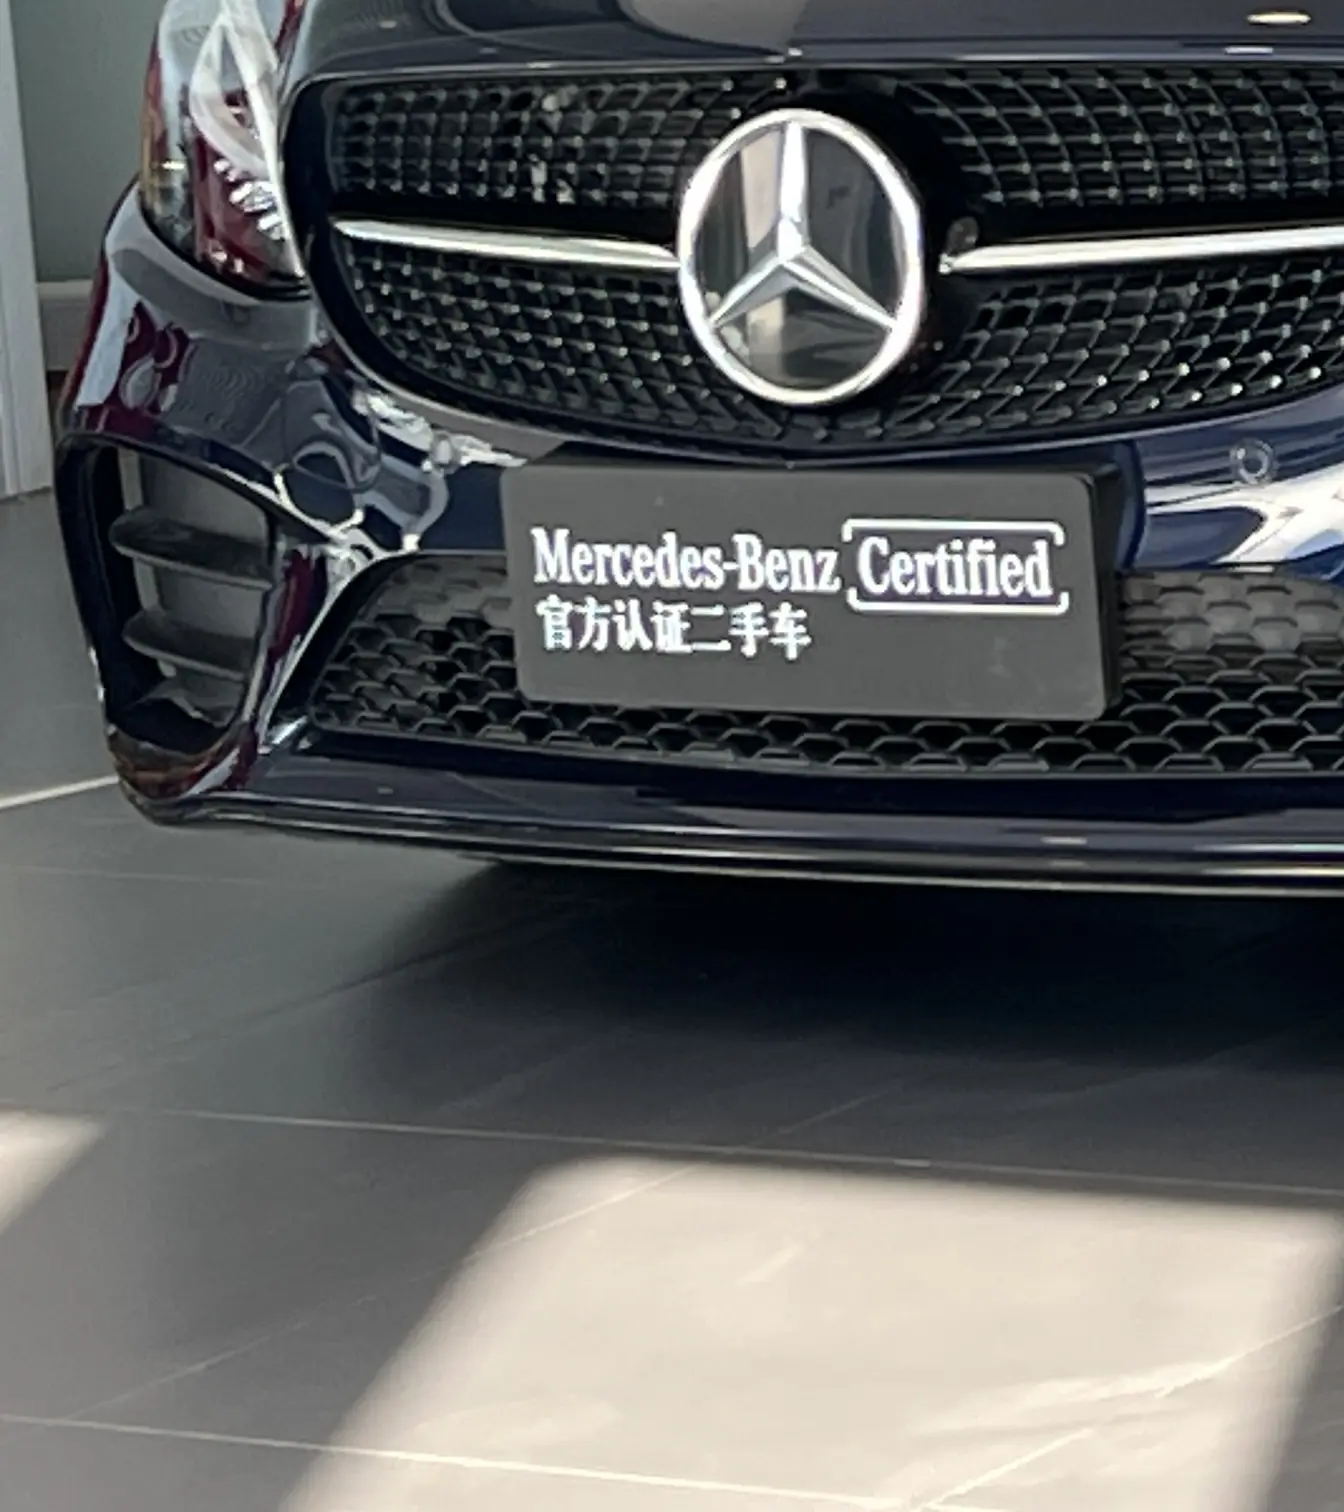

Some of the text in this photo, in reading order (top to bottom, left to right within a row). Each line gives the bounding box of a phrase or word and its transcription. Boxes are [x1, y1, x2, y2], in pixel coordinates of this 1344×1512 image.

[529, 526, 1055, 599] Mercedes-Benz Certified
[534, 592, 813, 661] 官方认证二手车
